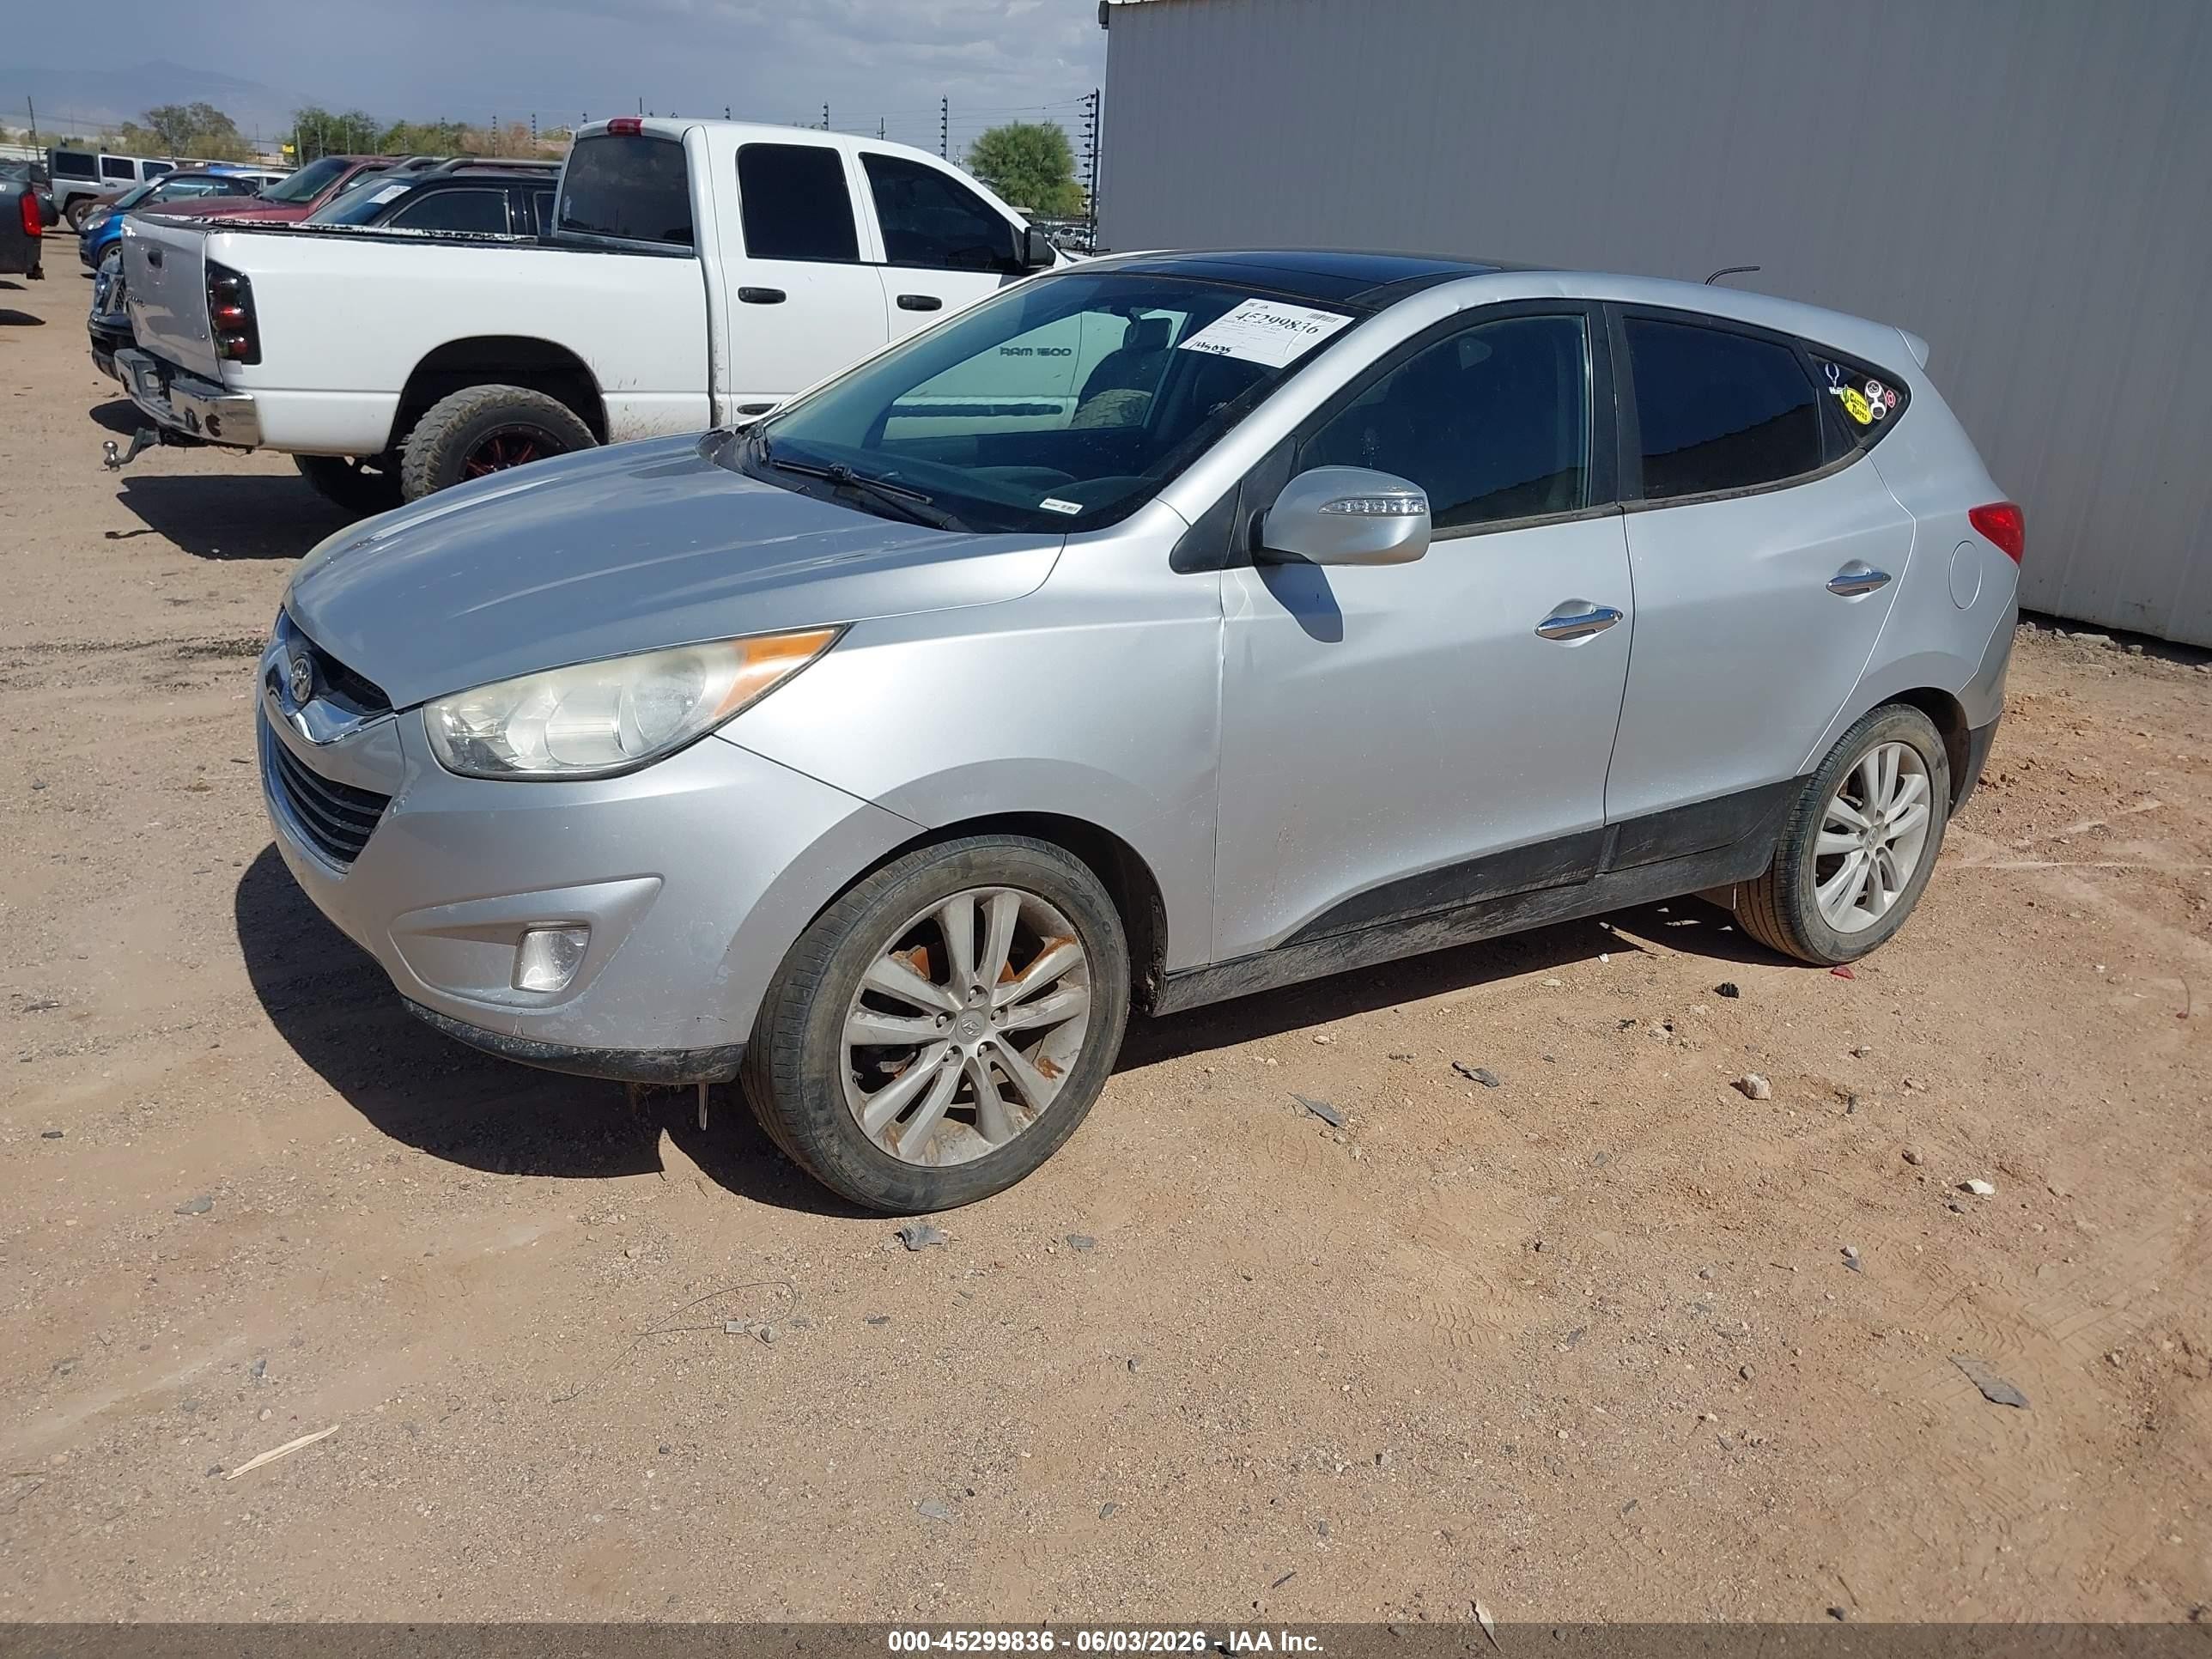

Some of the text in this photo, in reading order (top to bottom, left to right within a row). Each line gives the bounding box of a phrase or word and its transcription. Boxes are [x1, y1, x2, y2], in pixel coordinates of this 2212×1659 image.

[1235, 311, 1323, 334] 45299836
[1000, 346, 1073, 356] RAM 1500
